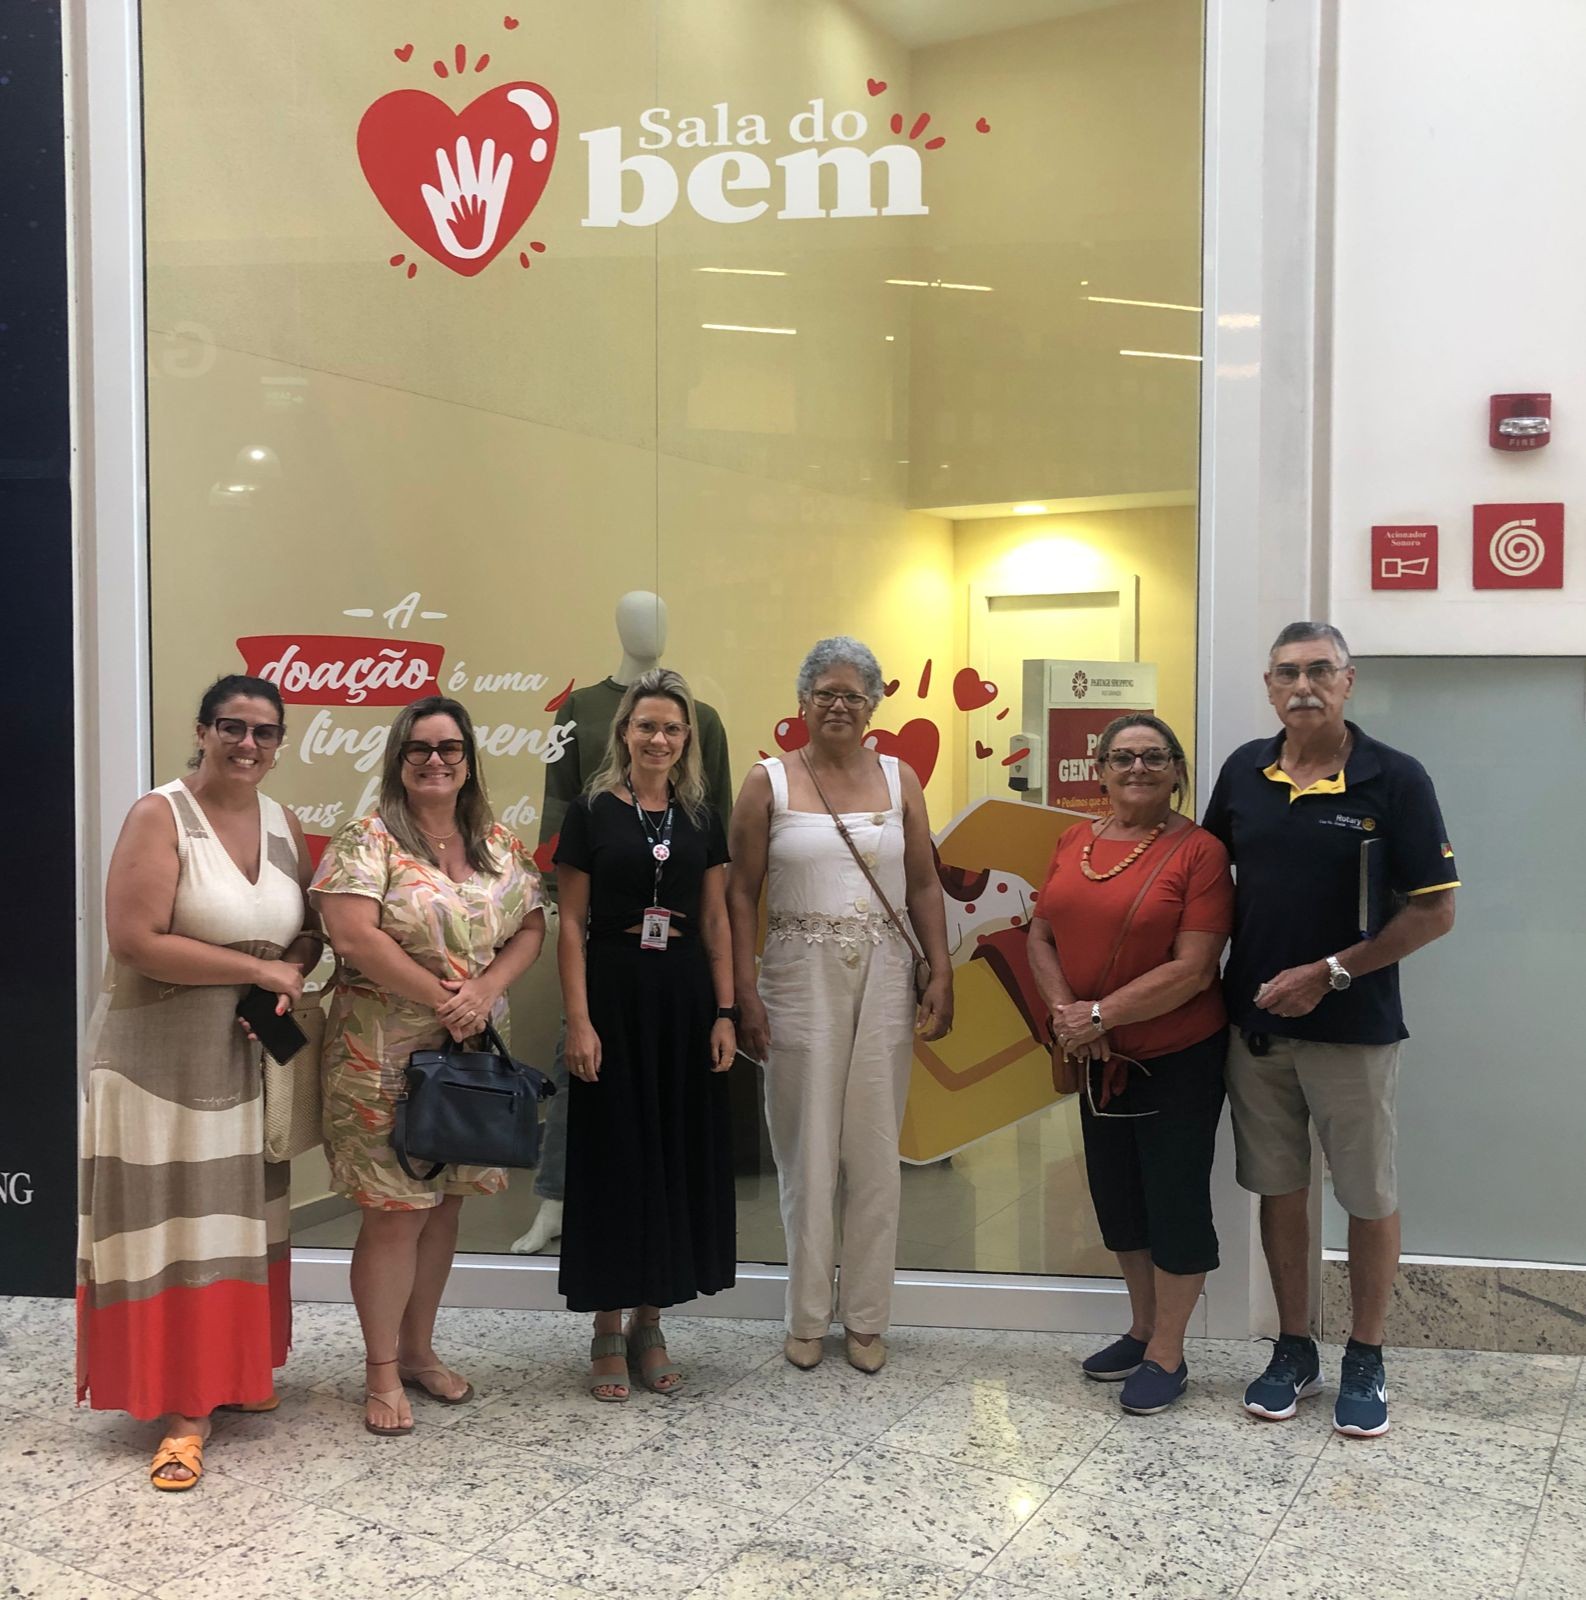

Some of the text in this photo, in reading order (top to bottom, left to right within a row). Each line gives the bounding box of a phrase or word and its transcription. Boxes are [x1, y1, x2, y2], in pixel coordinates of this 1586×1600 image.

[638, 98, 868, 150] Sala do
[578, 126, 930, 229] bem
[1508, 438, 1536, 447] FIRE
[1384, 530, 1428, 539] Acionador
[1390, 539, 1421, 547] Sonoro
[383, 591, 422, 630] A
[258, 644, 549, 704] doação é uma
[287, 801, 344, 829] ais
[501, 795, 539, 830] do
[1335, 814, 1362, 827] Rotary
